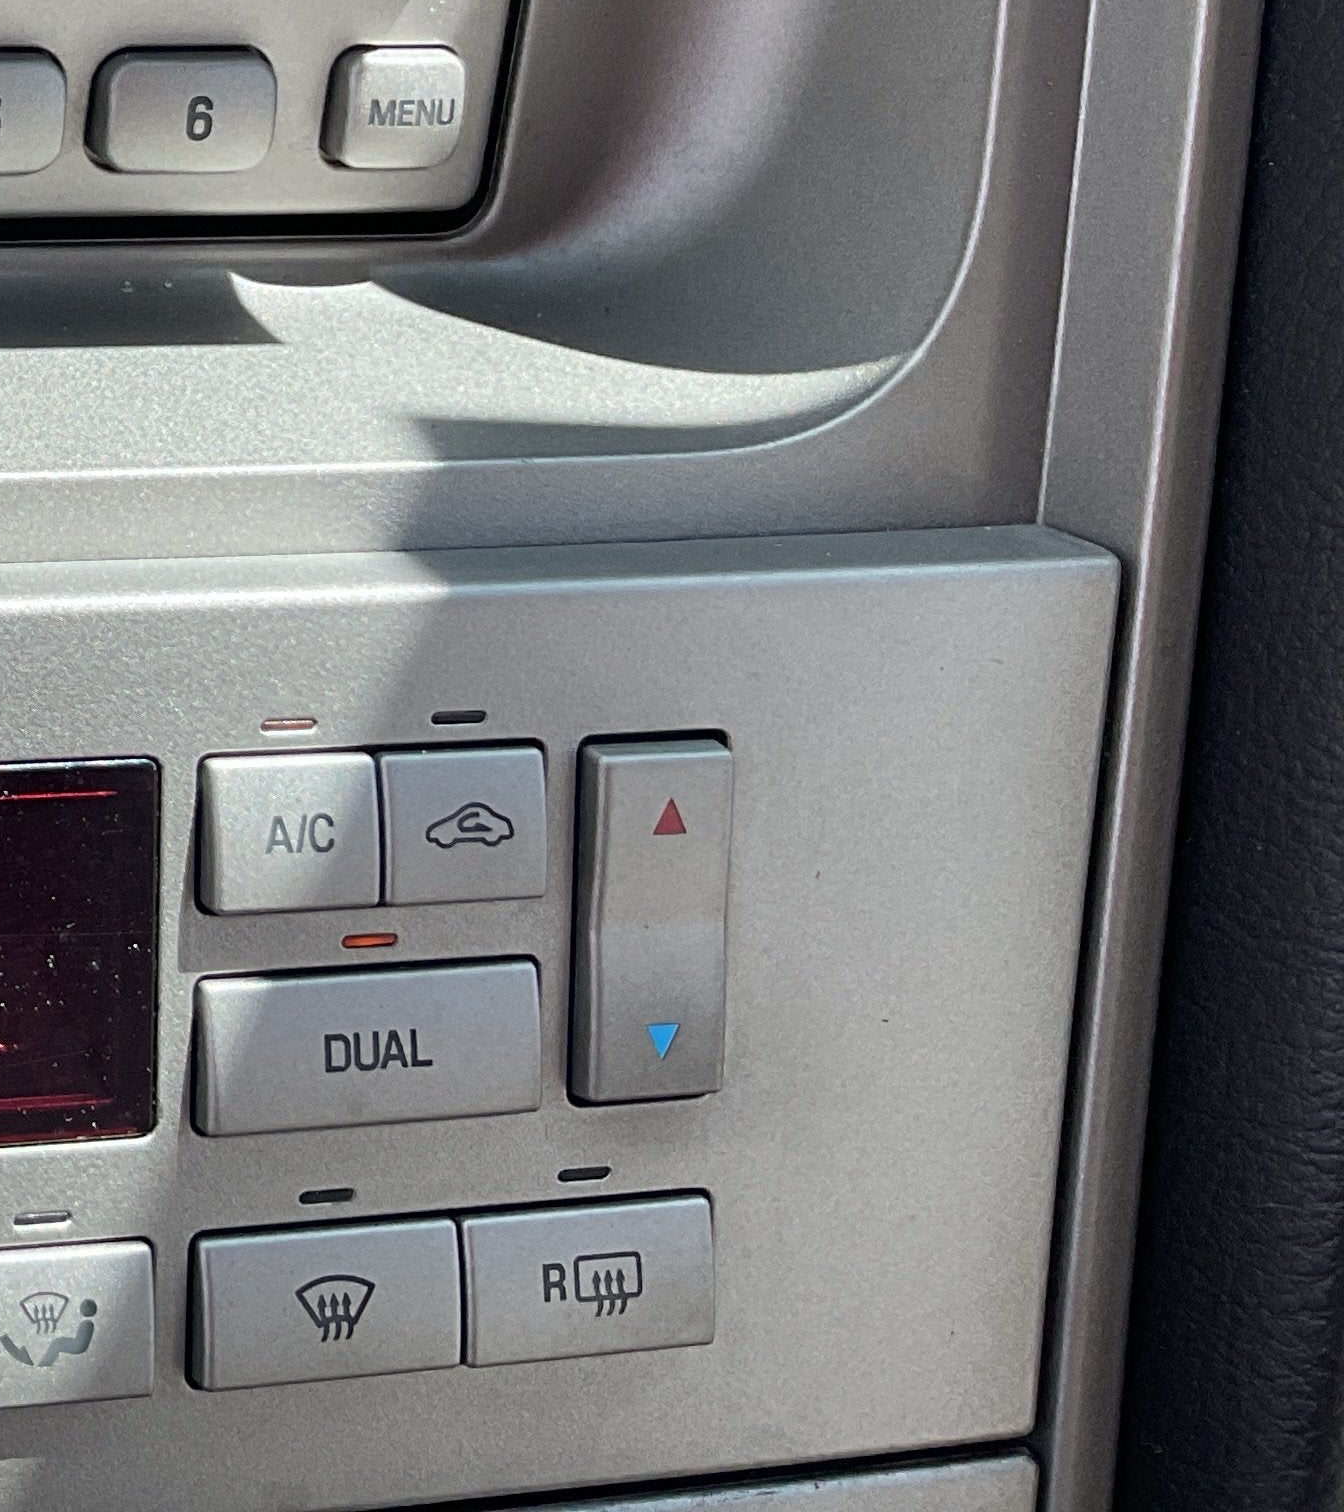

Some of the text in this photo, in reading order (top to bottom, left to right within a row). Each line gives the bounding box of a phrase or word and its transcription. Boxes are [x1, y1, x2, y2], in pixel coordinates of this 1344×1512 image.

[183, 94, 215, 143] 6
[366, 97, 457, 129] MENU
[264, 811, 336, 856] A/C
[322, 1028, 434, 1074] DUAL
[541, 1262, 568, 1303] R
